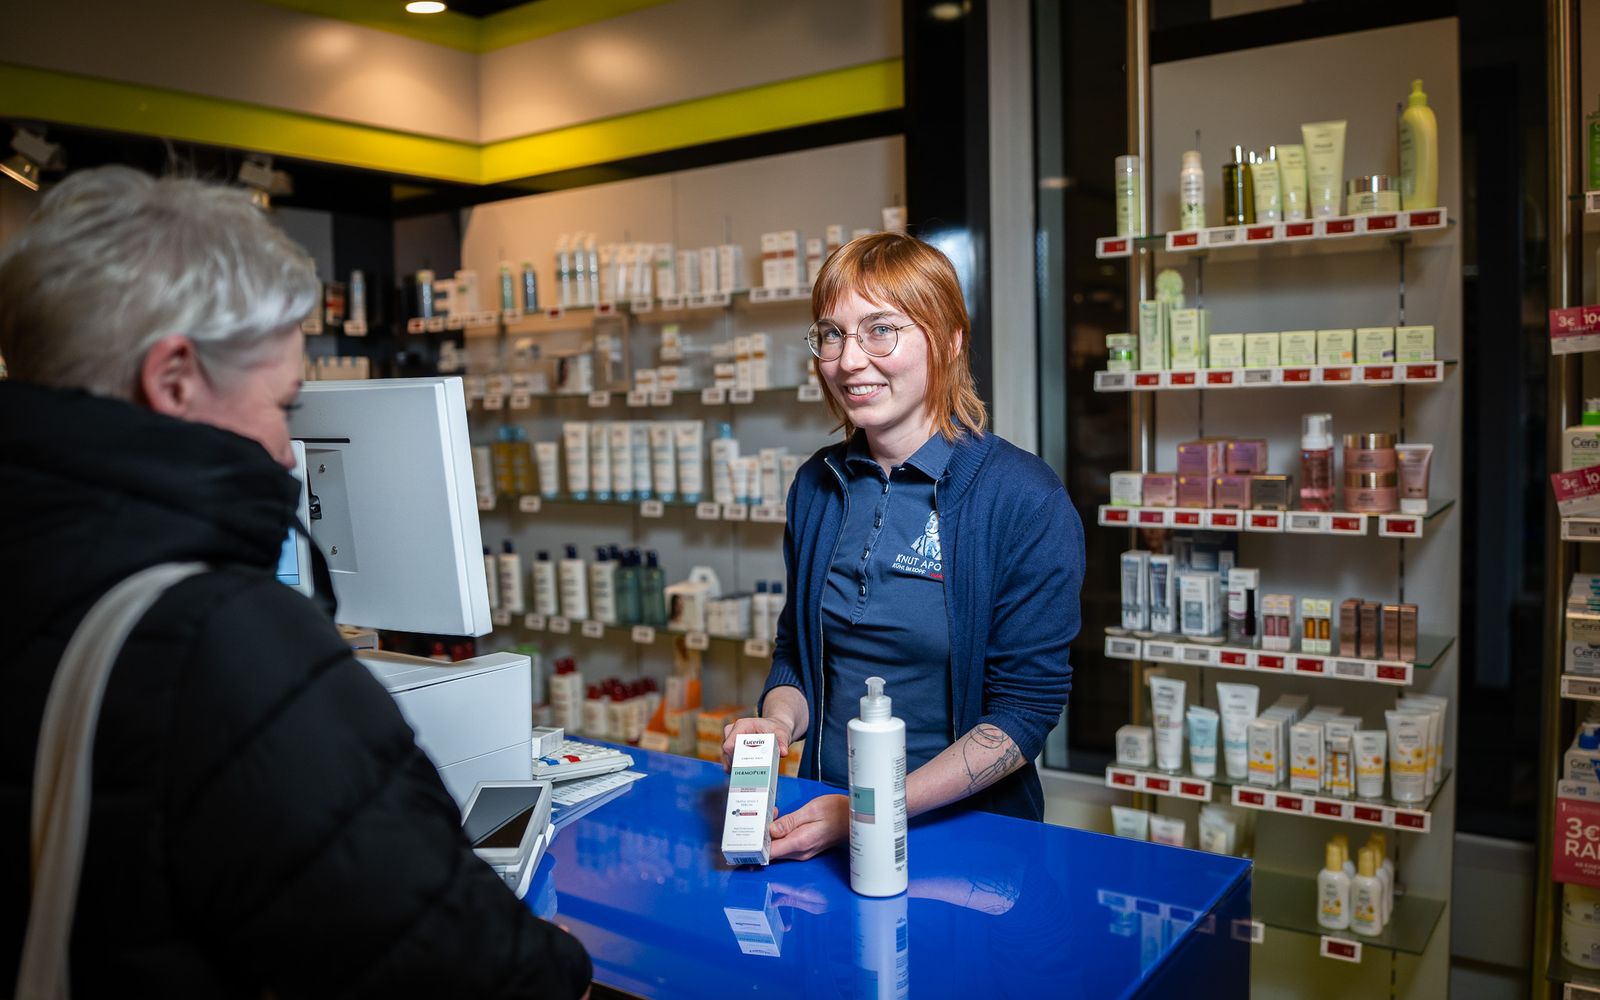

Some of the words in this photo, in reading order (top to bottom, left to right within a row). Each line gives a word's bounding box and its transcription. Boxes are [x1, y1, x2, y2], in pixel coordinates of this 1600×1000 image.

[1558, 316, 1576, 328] 3€
[1583, 312, 1600, 325] 10
[896, 554, 919, 566] KNUT
[921, 560, 942, 571] APO
[1566, 817, 1600, 842] 3€
[1565, 839, 1600, 861] RA
